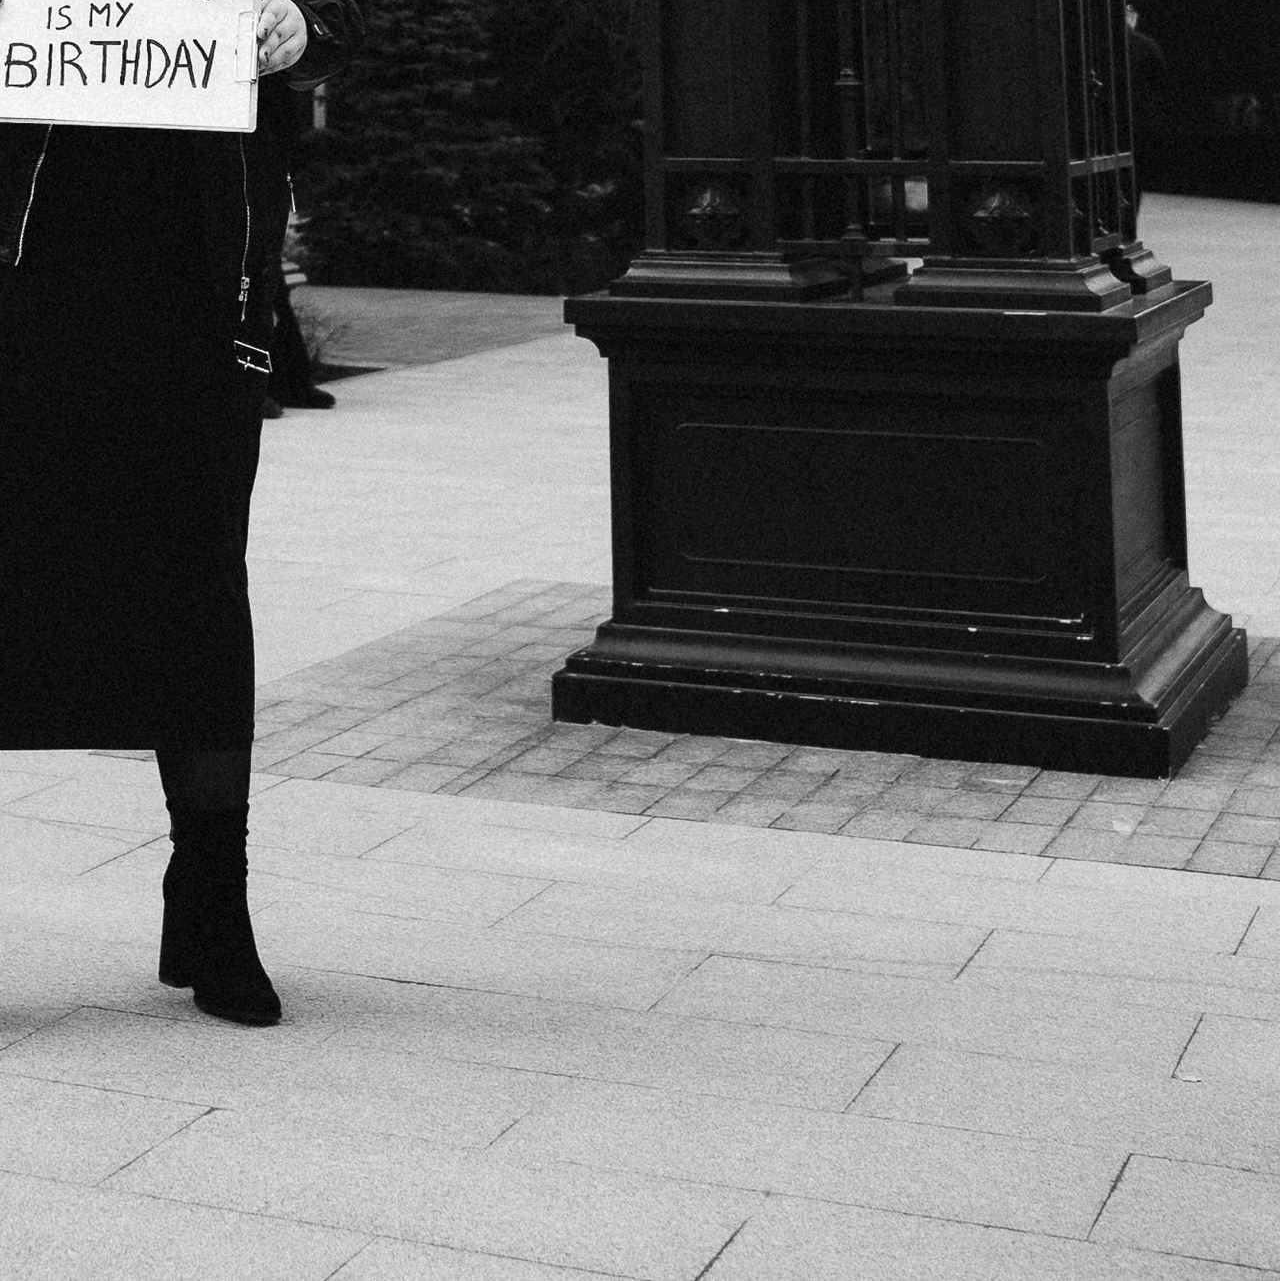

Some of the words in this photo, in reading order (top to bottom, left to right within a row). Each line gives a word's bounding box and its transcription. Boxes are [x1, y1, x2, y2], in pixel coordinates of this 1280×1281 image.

[46, 4, 73, 31] IS
[88, 1, 134, 28] MY
[4, 38, 217, 89] BIRTHDAY
